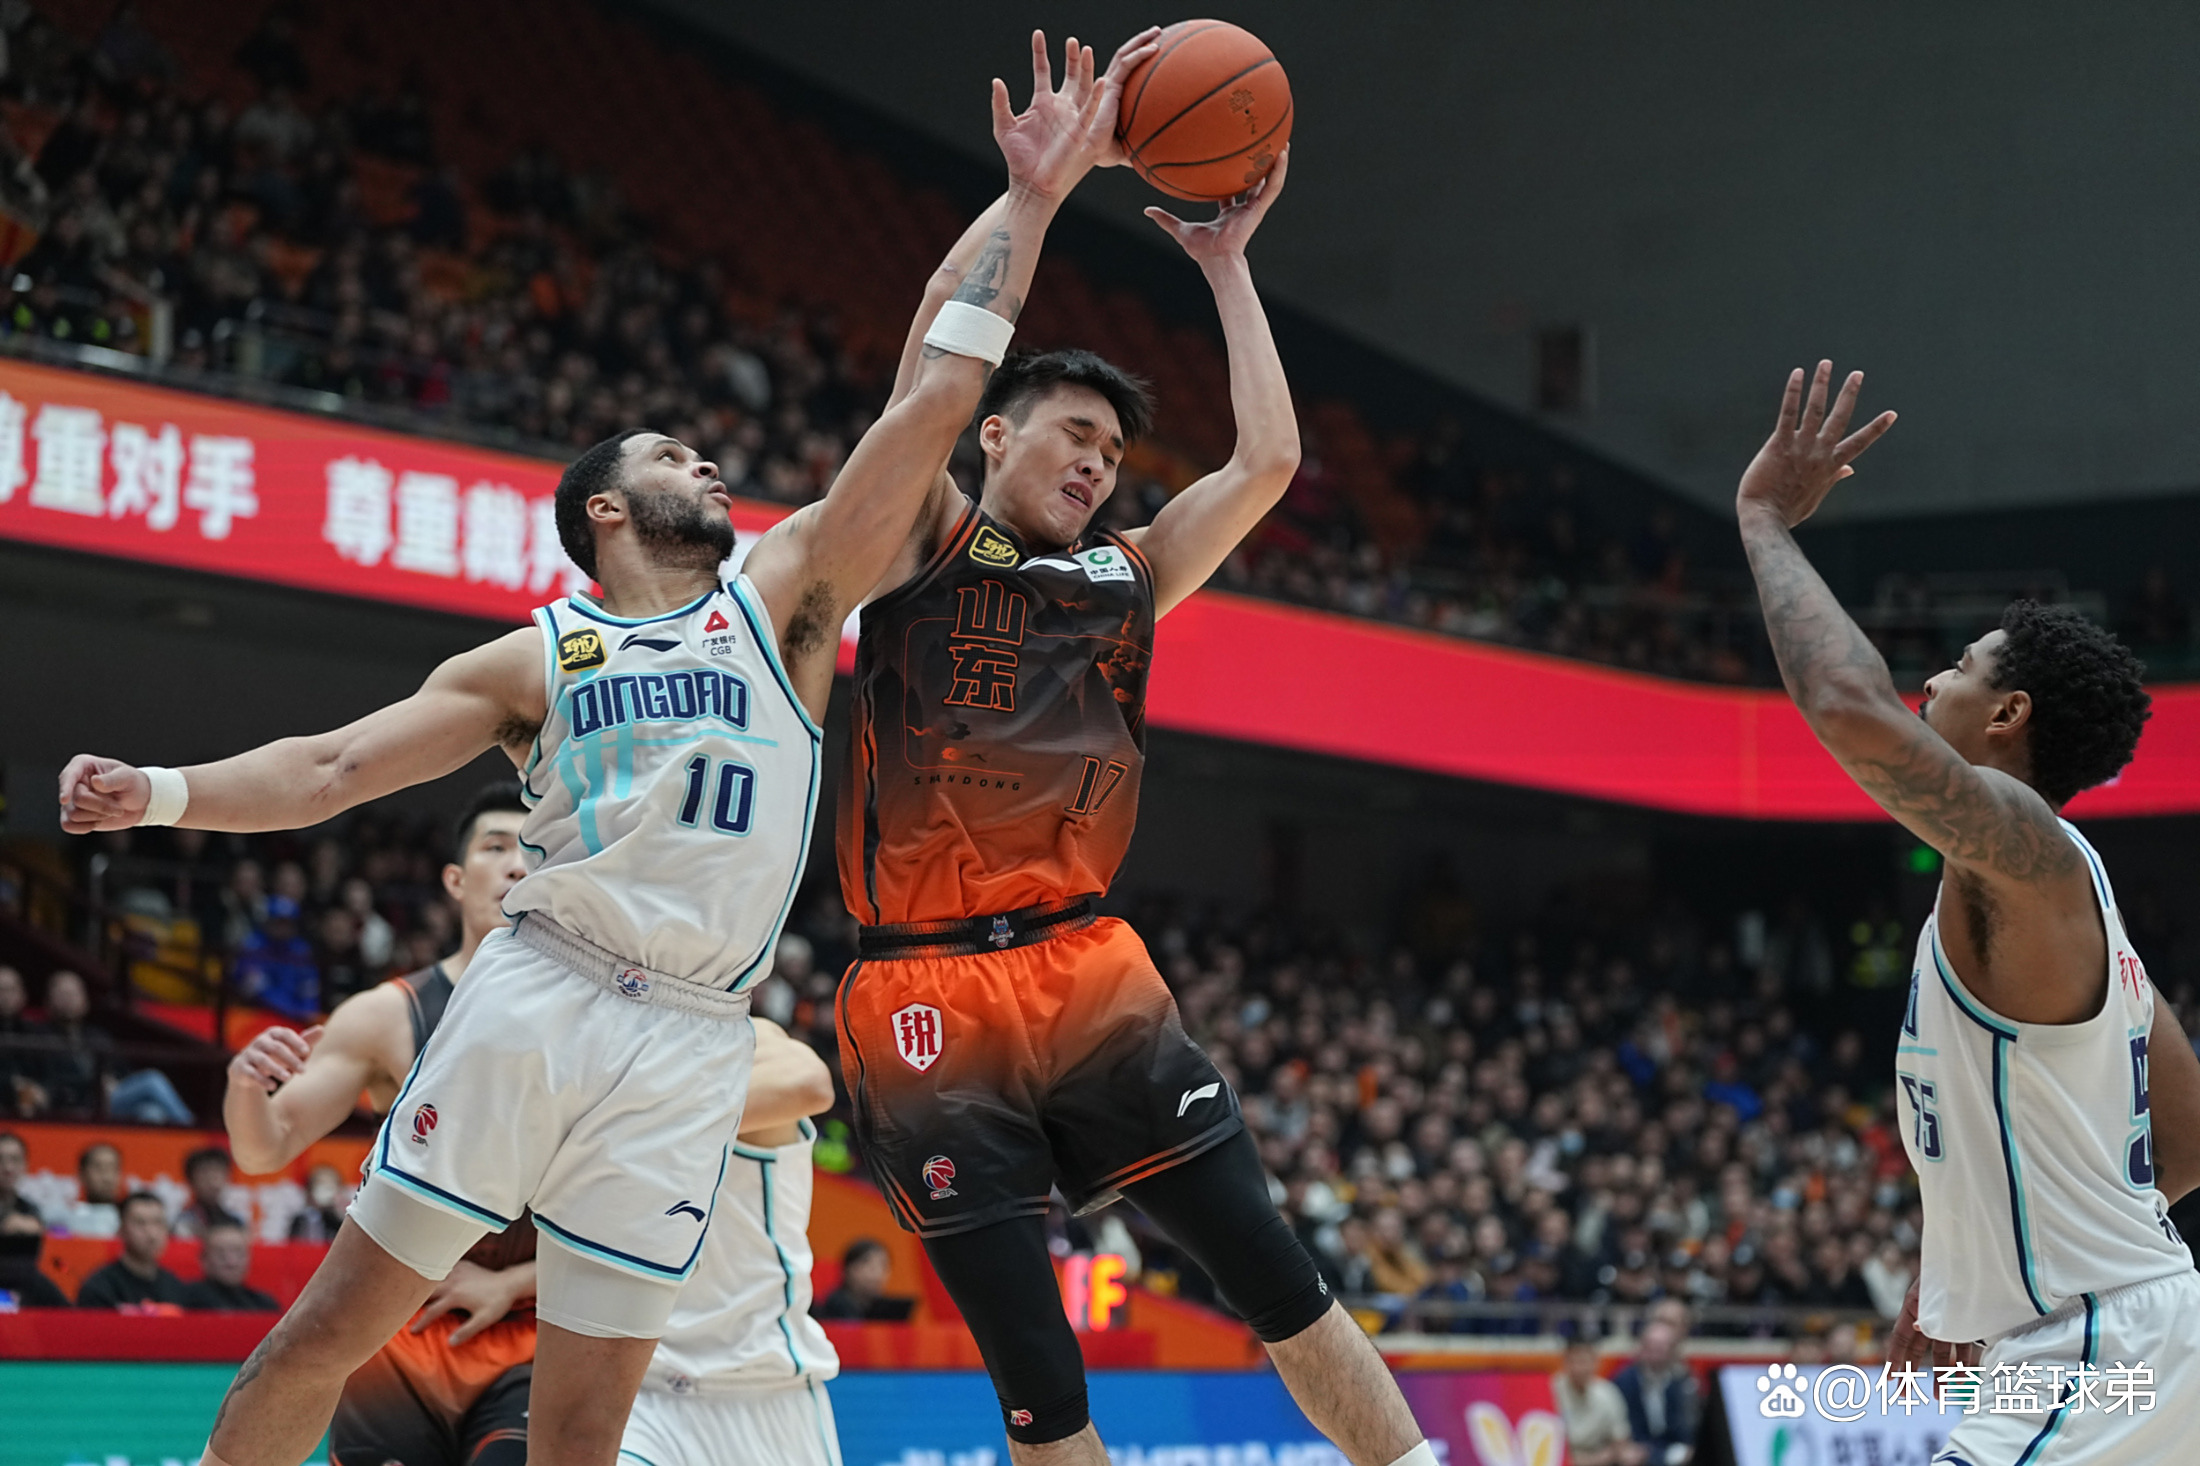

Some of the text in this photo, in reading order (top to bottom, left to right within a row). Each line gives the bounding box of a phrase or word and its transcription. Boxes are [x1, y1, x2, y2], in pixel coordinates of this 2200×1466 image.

[702, 635, 736, 648] 广发银行
[710, 645, 732, 656] CGB
[944, 579, 1026, 712] 山东
[570, 668, 750, 741] QINGDAO
[677, 752, 757, 837] 10
[1064, 755, 1128, 815] 17
[930, 1188, 958, 1200] CBA
